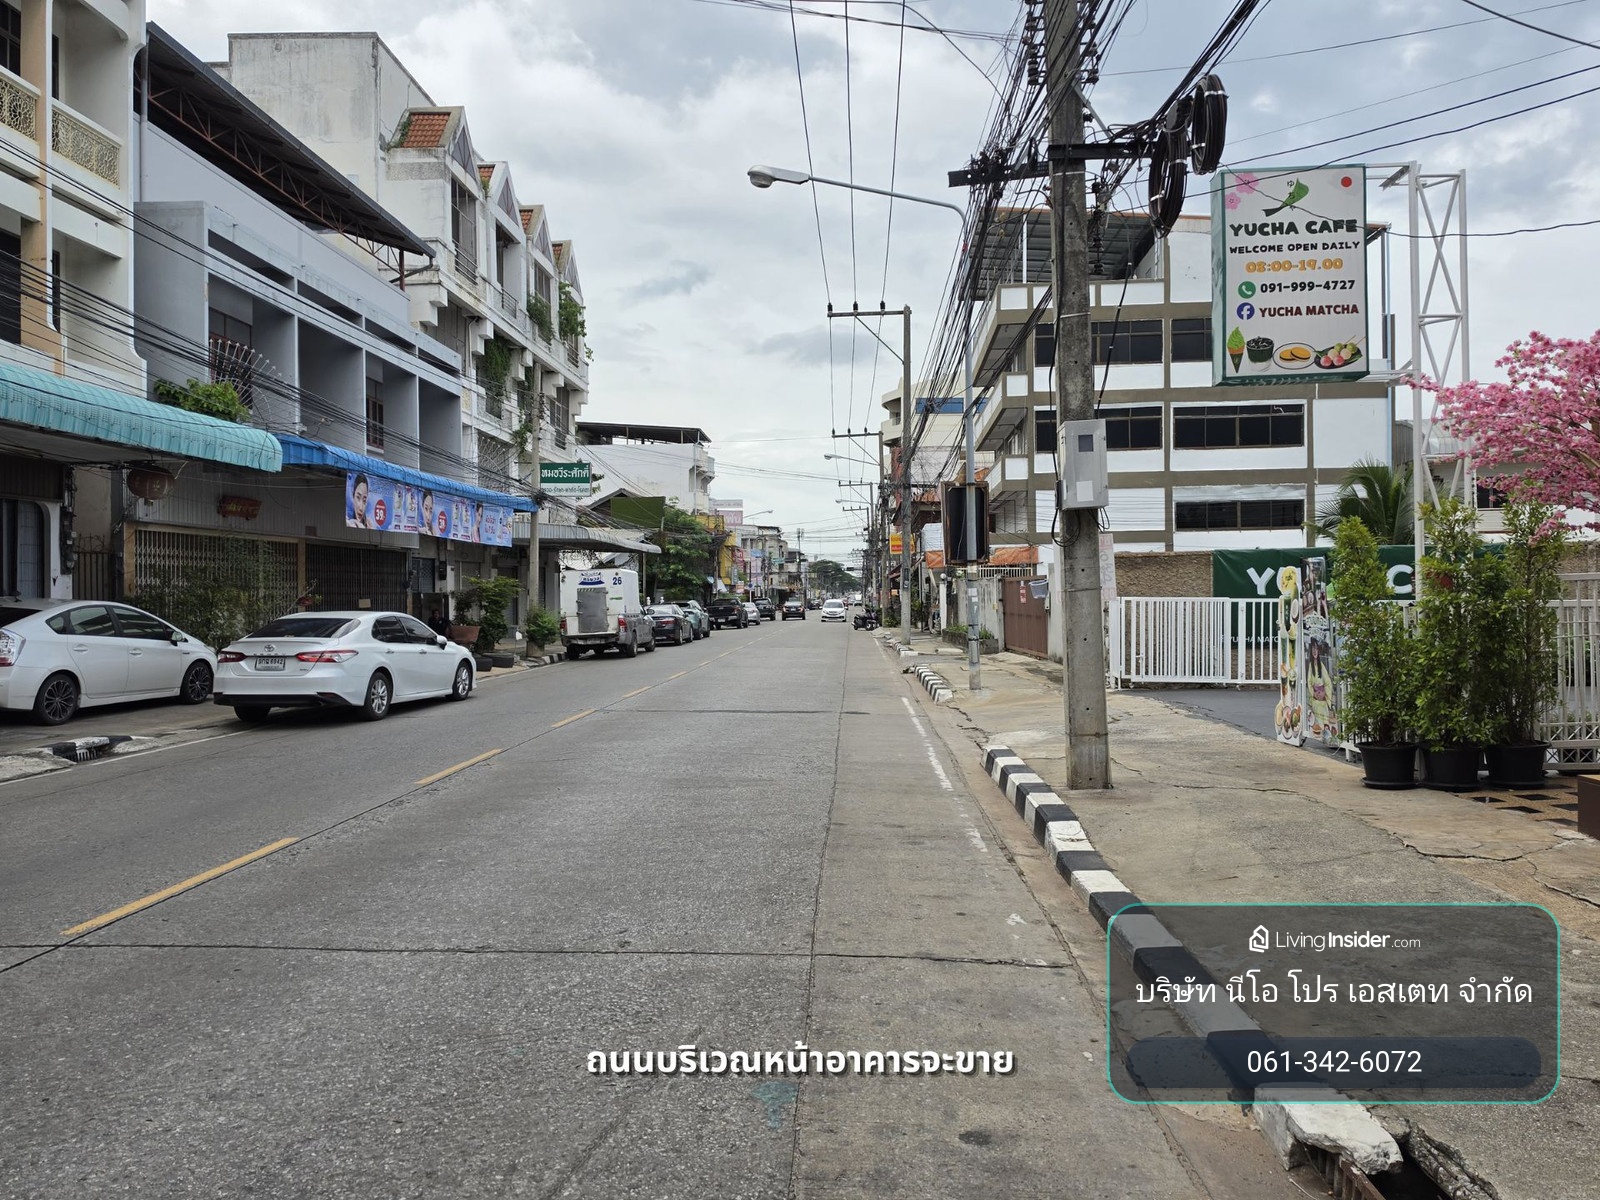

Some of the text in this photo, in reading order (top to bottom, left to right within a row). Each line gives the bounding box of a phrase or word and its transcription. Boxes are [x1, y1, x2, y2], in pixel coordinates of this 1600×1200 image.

[1229, 219, 1358, 237] YUCHA CAFE
[1229, 241, 1361, 254] WELCOME OPEN DAILY
[1245, 258, 1344, 274] 08:00-19.00
[1260, 280, 1356, 294] 091-999-4727
[1258, 304, 1359, 318] YUCHA MATCHA
[612, 576, 623, 586] 26
